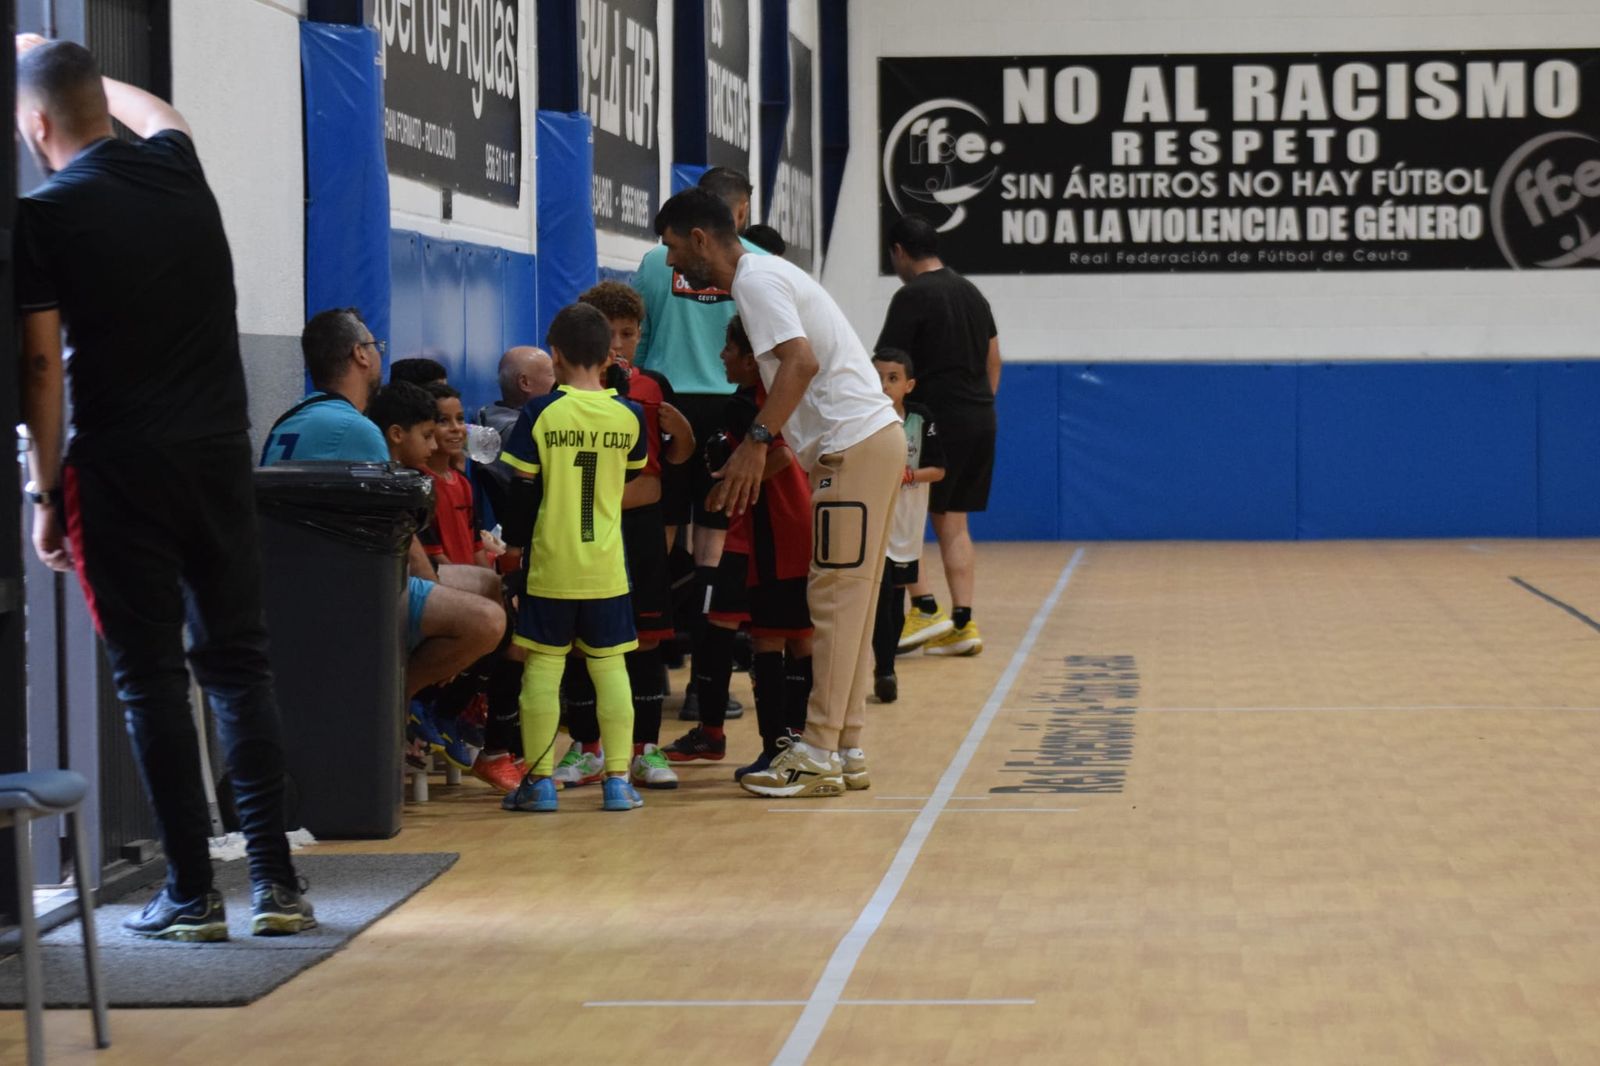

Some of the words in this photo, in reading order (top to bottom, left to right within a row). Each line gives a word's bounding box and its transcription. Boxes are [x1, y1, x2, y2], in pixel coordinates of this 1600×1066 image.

[1002, 66, 1100, 124] NO
[1123, 65, 1208, 123] AL
[1231, 59, 1580, 122] RACISMO
[1111, 128, 1380, 166] RESPETO
[1000, 173, 1053, 200] SIN
[1062, 165, 1220, 199] ÁRBITROS
[1228, 170, 1282, 198] NO
[1291, 170, 1360, 197] HAY
[1371, 161, 1489, 196] FÚTBOL
[1002, 209, 1047, 244] NO
[1054, 209, 1078, 244] A
[1083, 208, 1123, 243] LA
[1128, 207, 1300, 243] VIOLENCIA
[1306, 207, 1349, 242] DE
[1354, 200, 1484, 241] GÉNERO
[1070, 251, 1109, 264] Real
[1116, 250, 1219, 264] Federación
[1227, 250, 1250, 263] de
[1258, 249, 1315, 262] Fútbol
[1322, 249, 1345, 262] de
[1352, 249, 1409, 262] Ceuta
[590, 431, 598, 448] Y
[573, 451, 598, 543] 1
